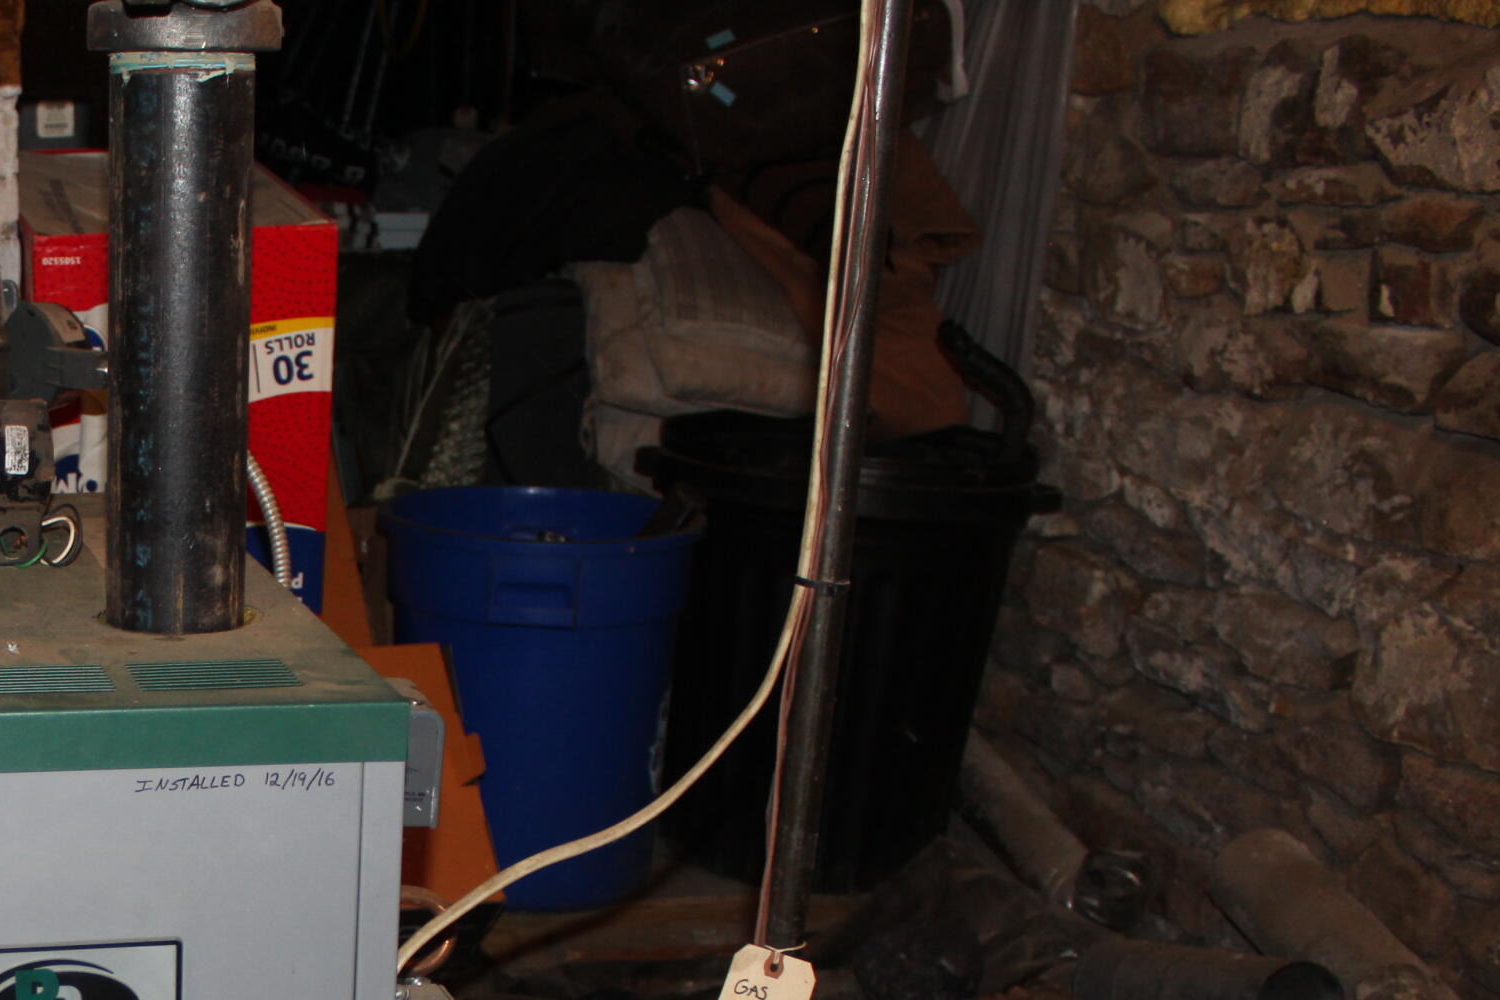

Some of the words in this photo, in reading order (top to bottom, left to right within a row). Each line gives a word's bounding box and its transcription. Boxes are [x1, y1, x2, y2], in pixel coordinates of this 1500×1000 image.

[264, 332, 316, 356] ROLLS
[272, 350, 315, 386] 30
[134, 773, 246, 793] INSTALLED
[264, 768, 336, 792] 12/19/16
[733, 978, 769, 1000] GAS
